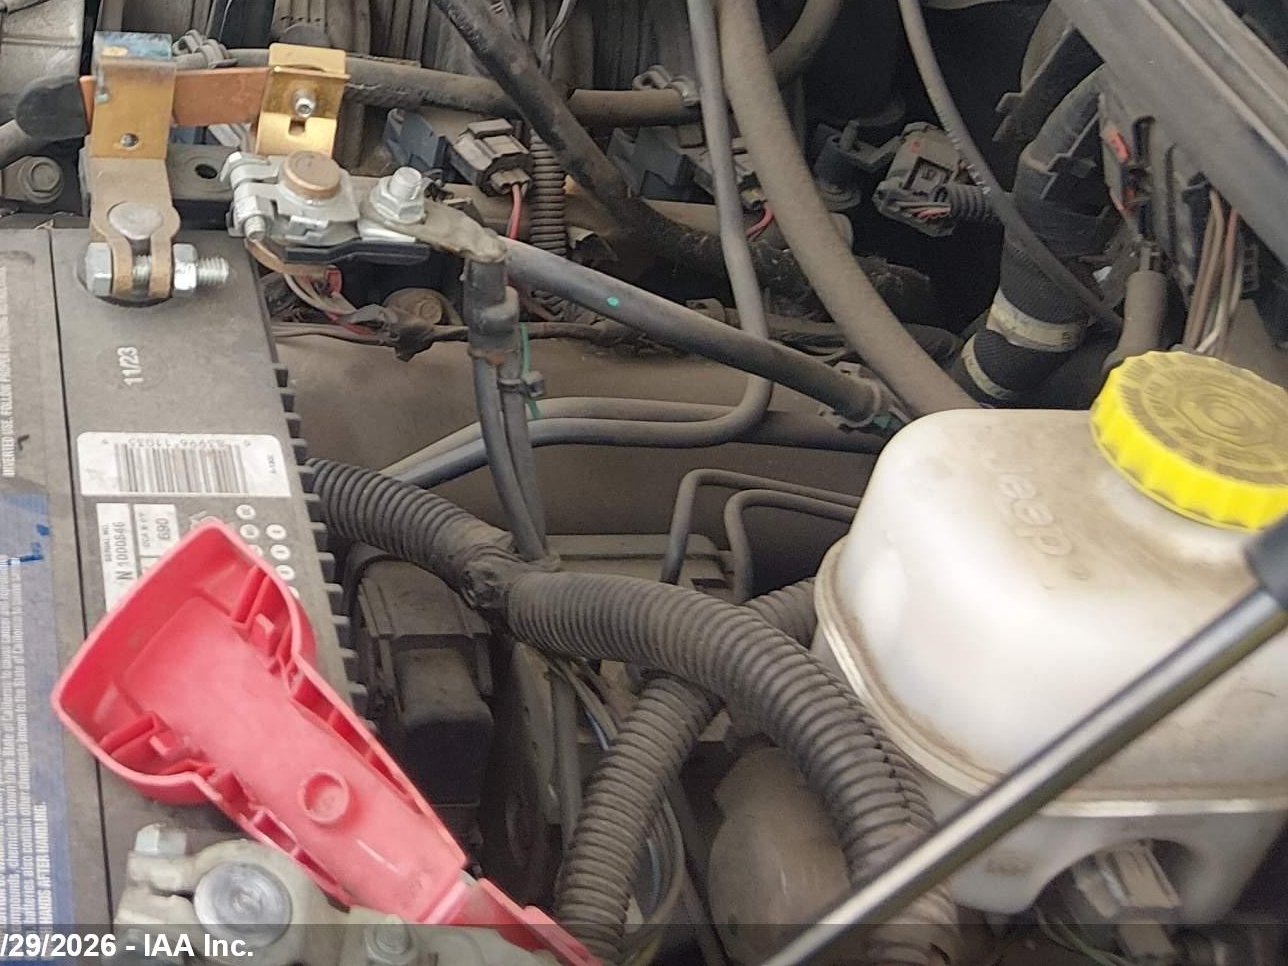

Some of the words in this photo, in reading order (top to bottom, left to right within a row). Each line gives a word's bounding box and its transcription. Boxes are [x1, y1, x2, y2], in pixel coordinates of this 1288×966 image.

[117, 345, 145, 387] 11/23
[155, 517, 171, 541] 690
[35, 854, 52, 888] AFTER
[37, 889, 53, 924] HANDS
